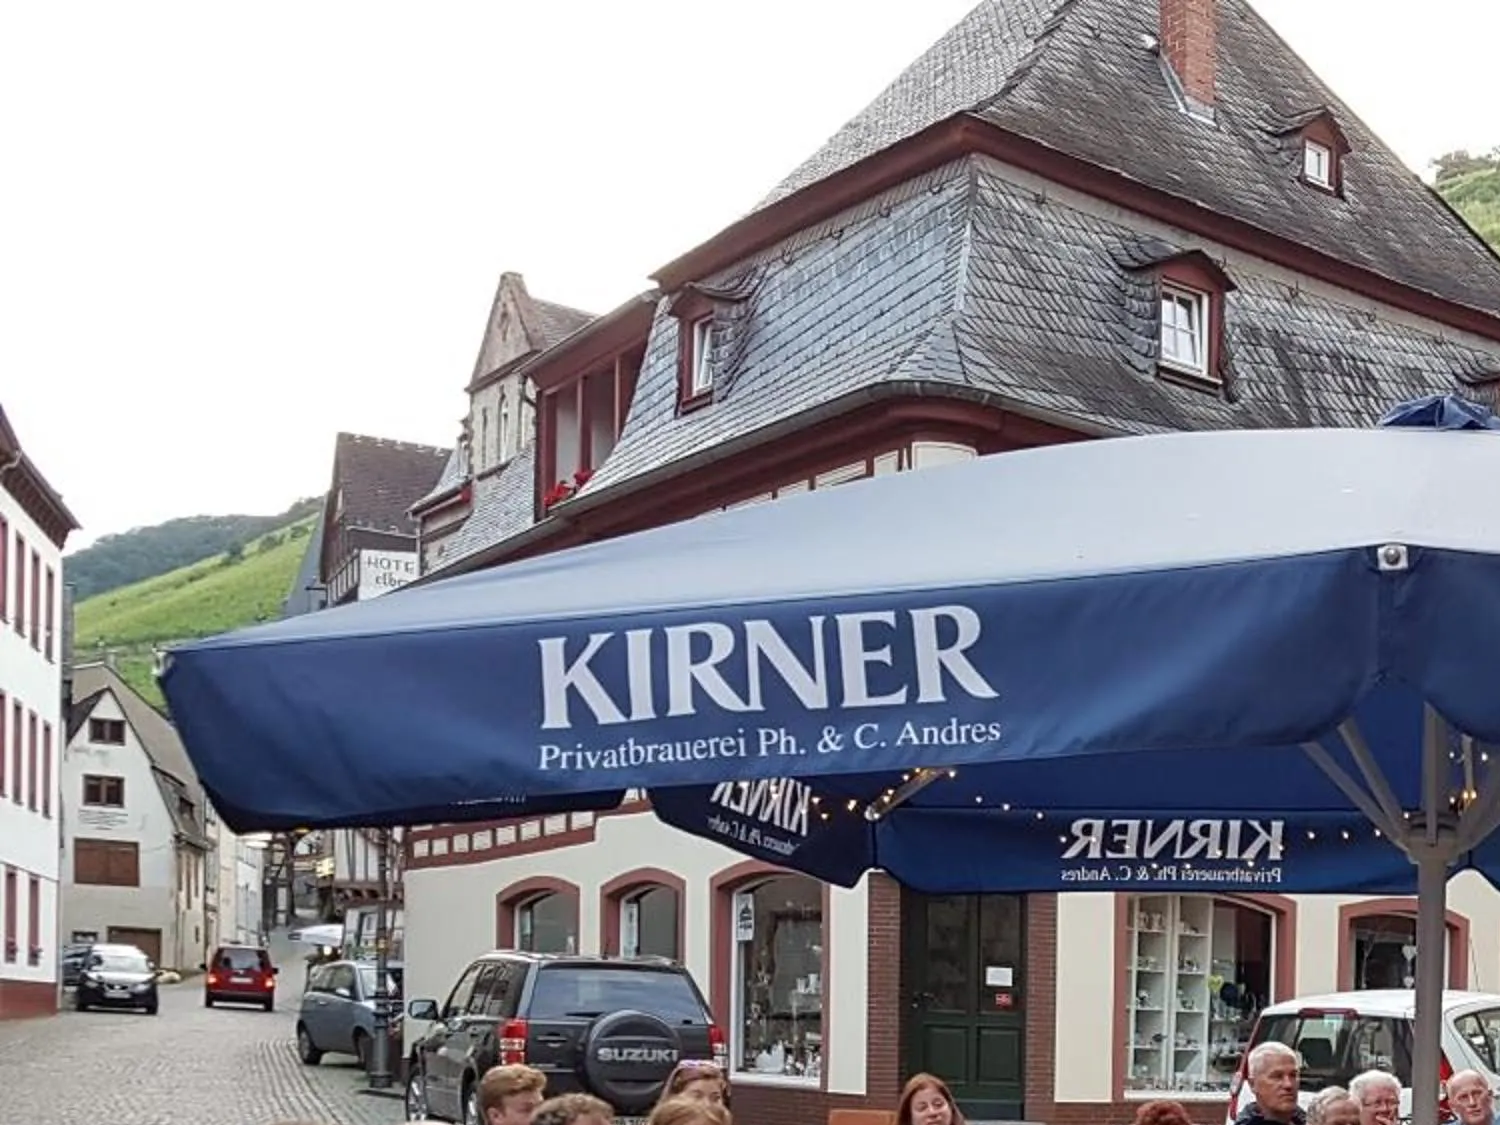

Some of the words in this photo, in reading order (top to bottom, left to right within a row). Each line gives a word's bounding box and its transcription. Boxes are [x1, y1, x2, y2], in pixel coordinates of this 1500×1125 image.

[538, 604, 1000, 729] KIRNER
[538, 729, 747, 771] Privatbrauerei
[758, 728, 805, 757] Ph.
[818, 726, 844, 752] &
[854, 723, 887, 749] C.
[897, 719, 1001, 747] Andres
[597, 1047, 678, 1062] SUZUKI
